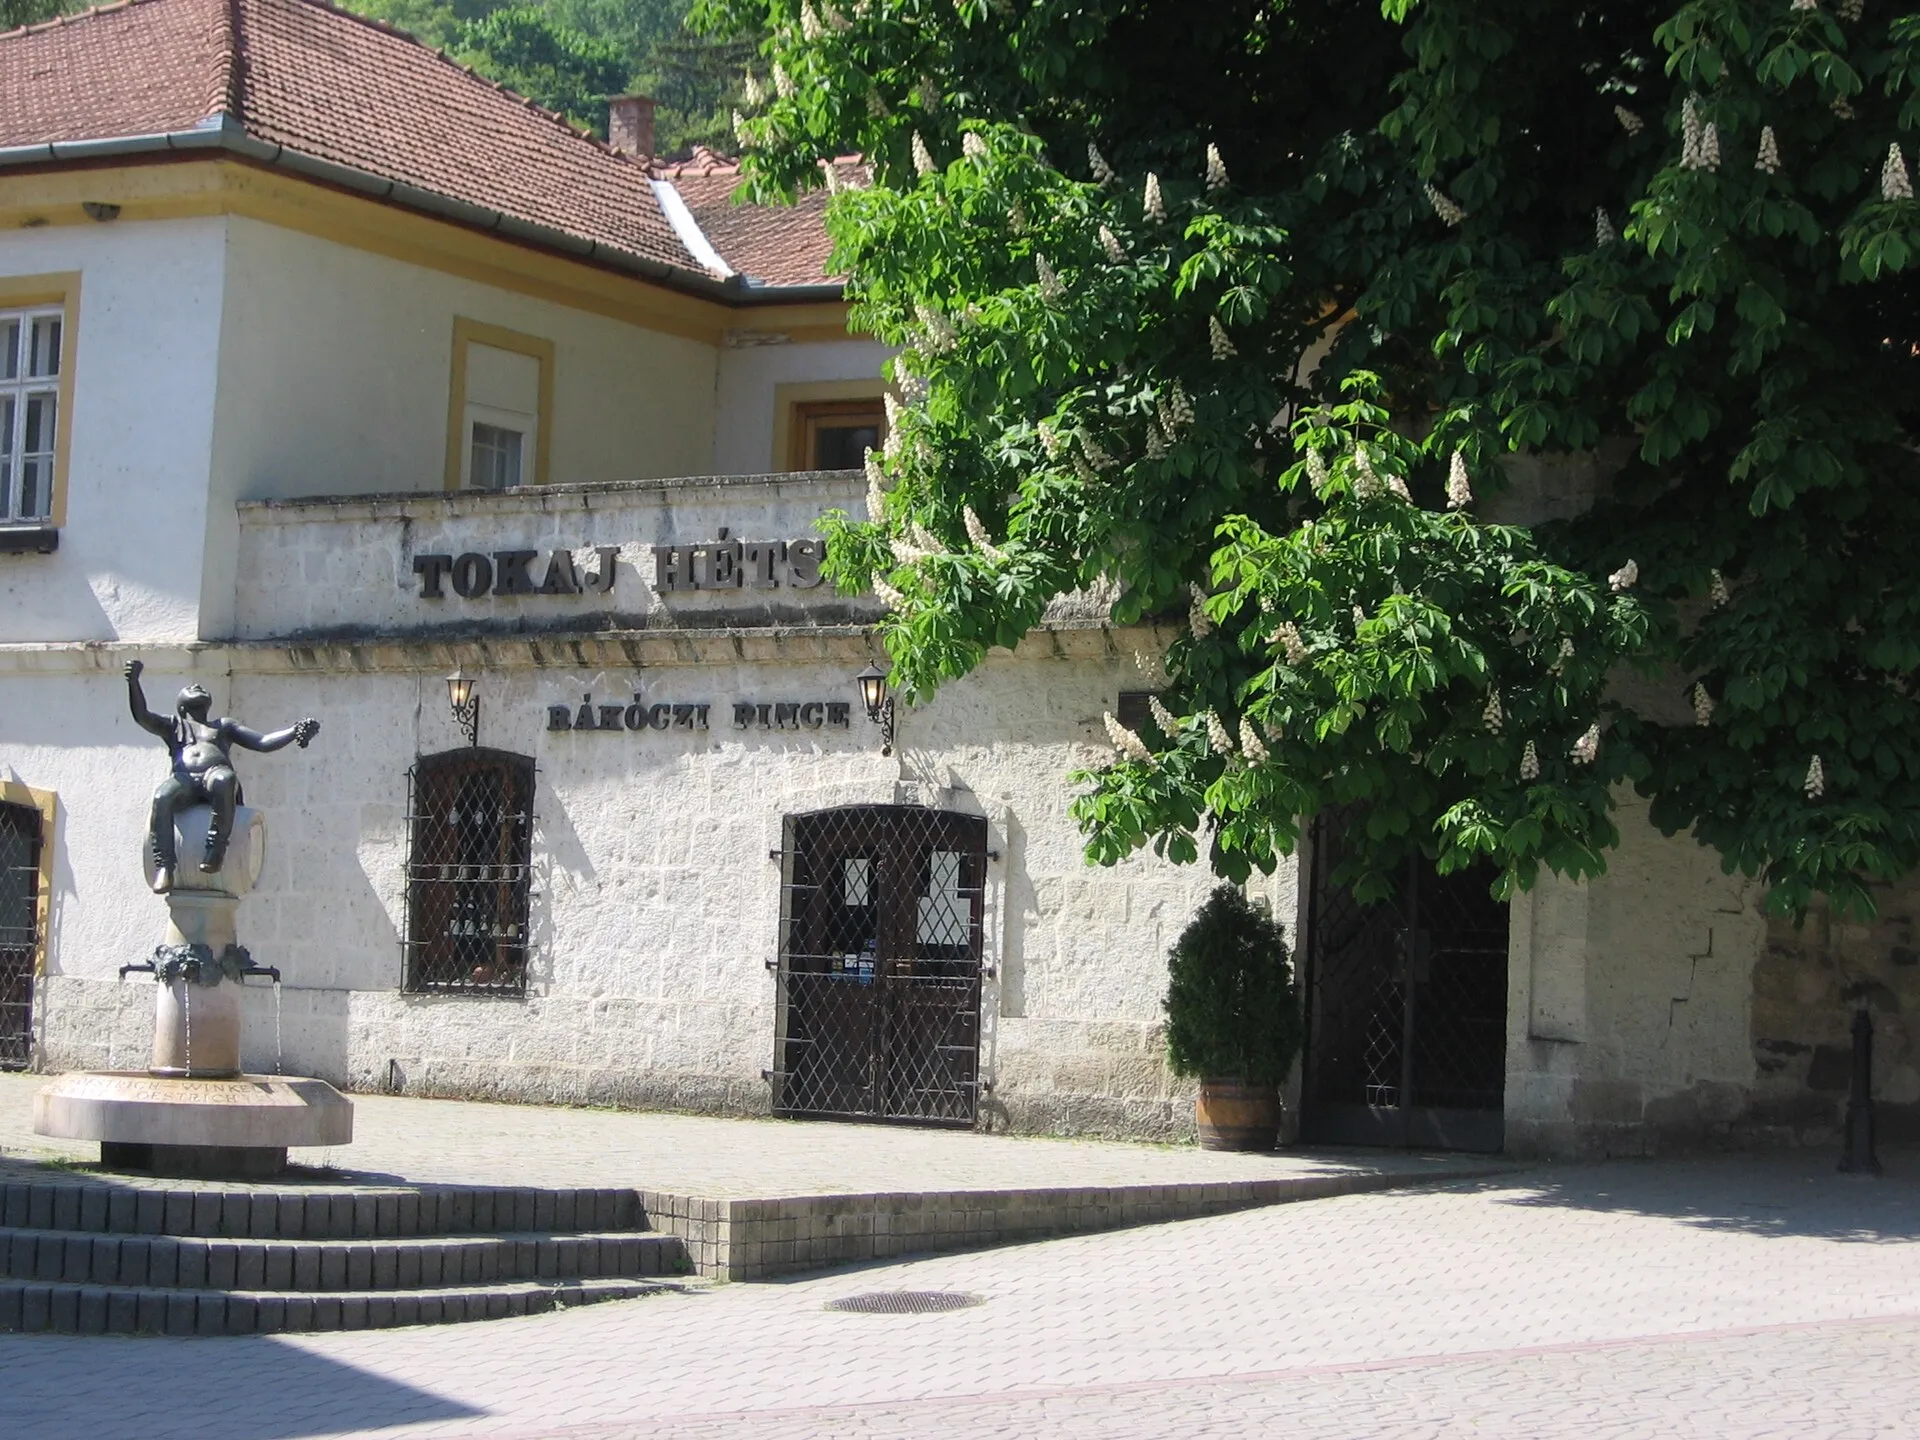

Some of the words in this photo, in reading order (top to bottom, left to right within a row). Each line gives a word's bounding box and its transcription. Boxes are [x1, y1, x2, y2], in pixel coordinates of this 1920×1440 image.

[413, 546, 621, 599] TOKAJ
[547, 693, 710, 731] RÁKÓCZI
[733, 702, 851, 730] PINCE
